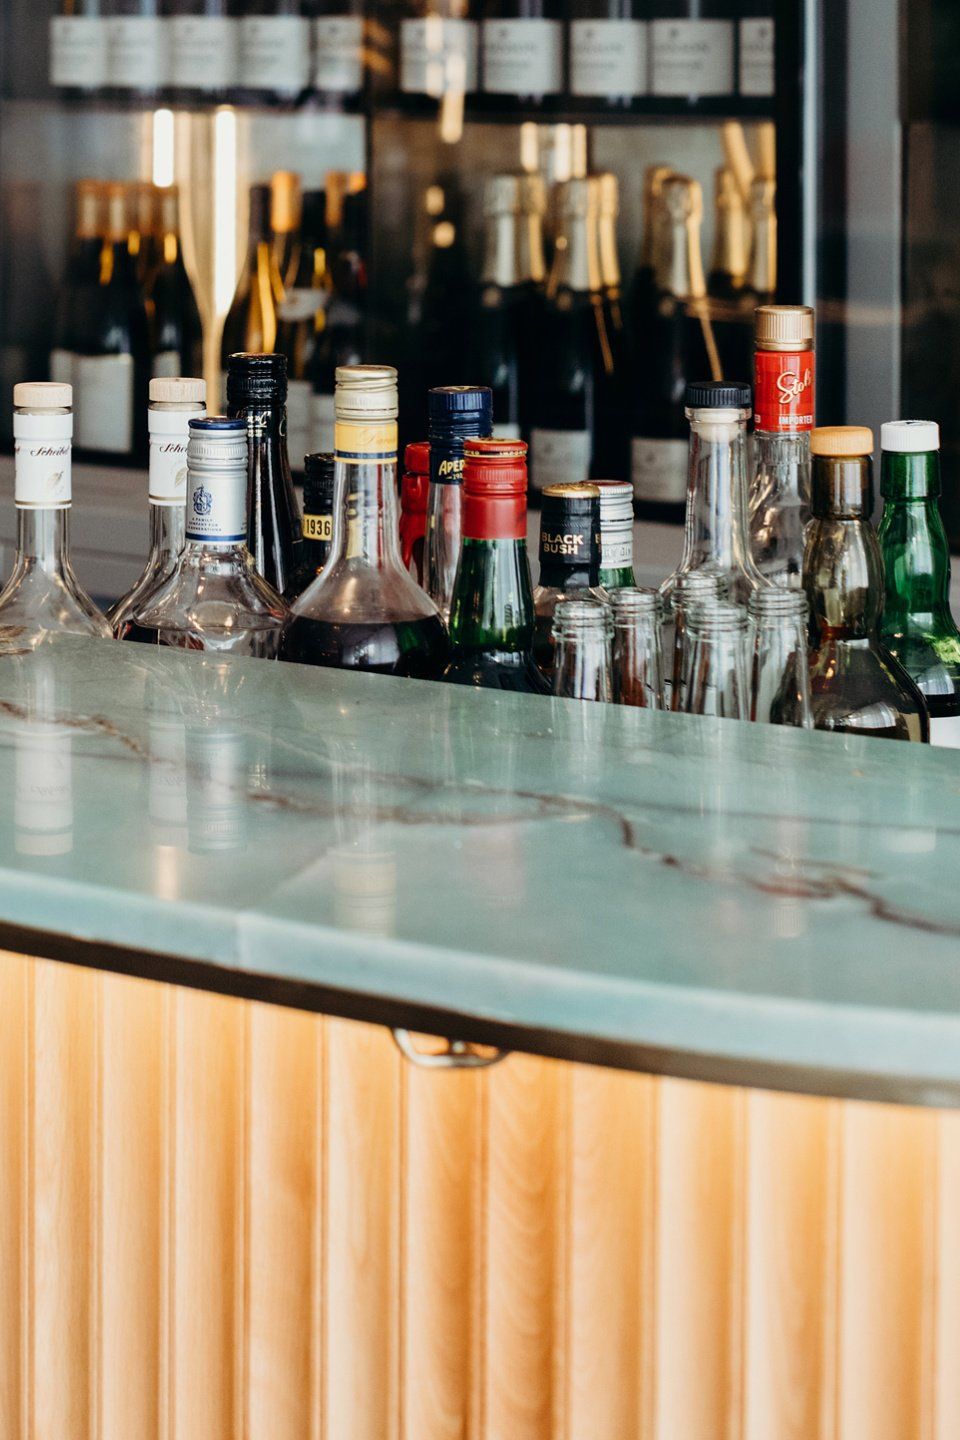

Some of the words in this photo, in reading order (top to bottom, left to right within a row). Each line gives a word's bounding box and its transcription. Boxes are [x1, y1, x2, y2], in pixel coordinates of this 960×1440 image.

[305, 519, 332, 536] 1936
[541, 531, 584, 545] BLACK
[543, 543, 579, 555] BUSH
